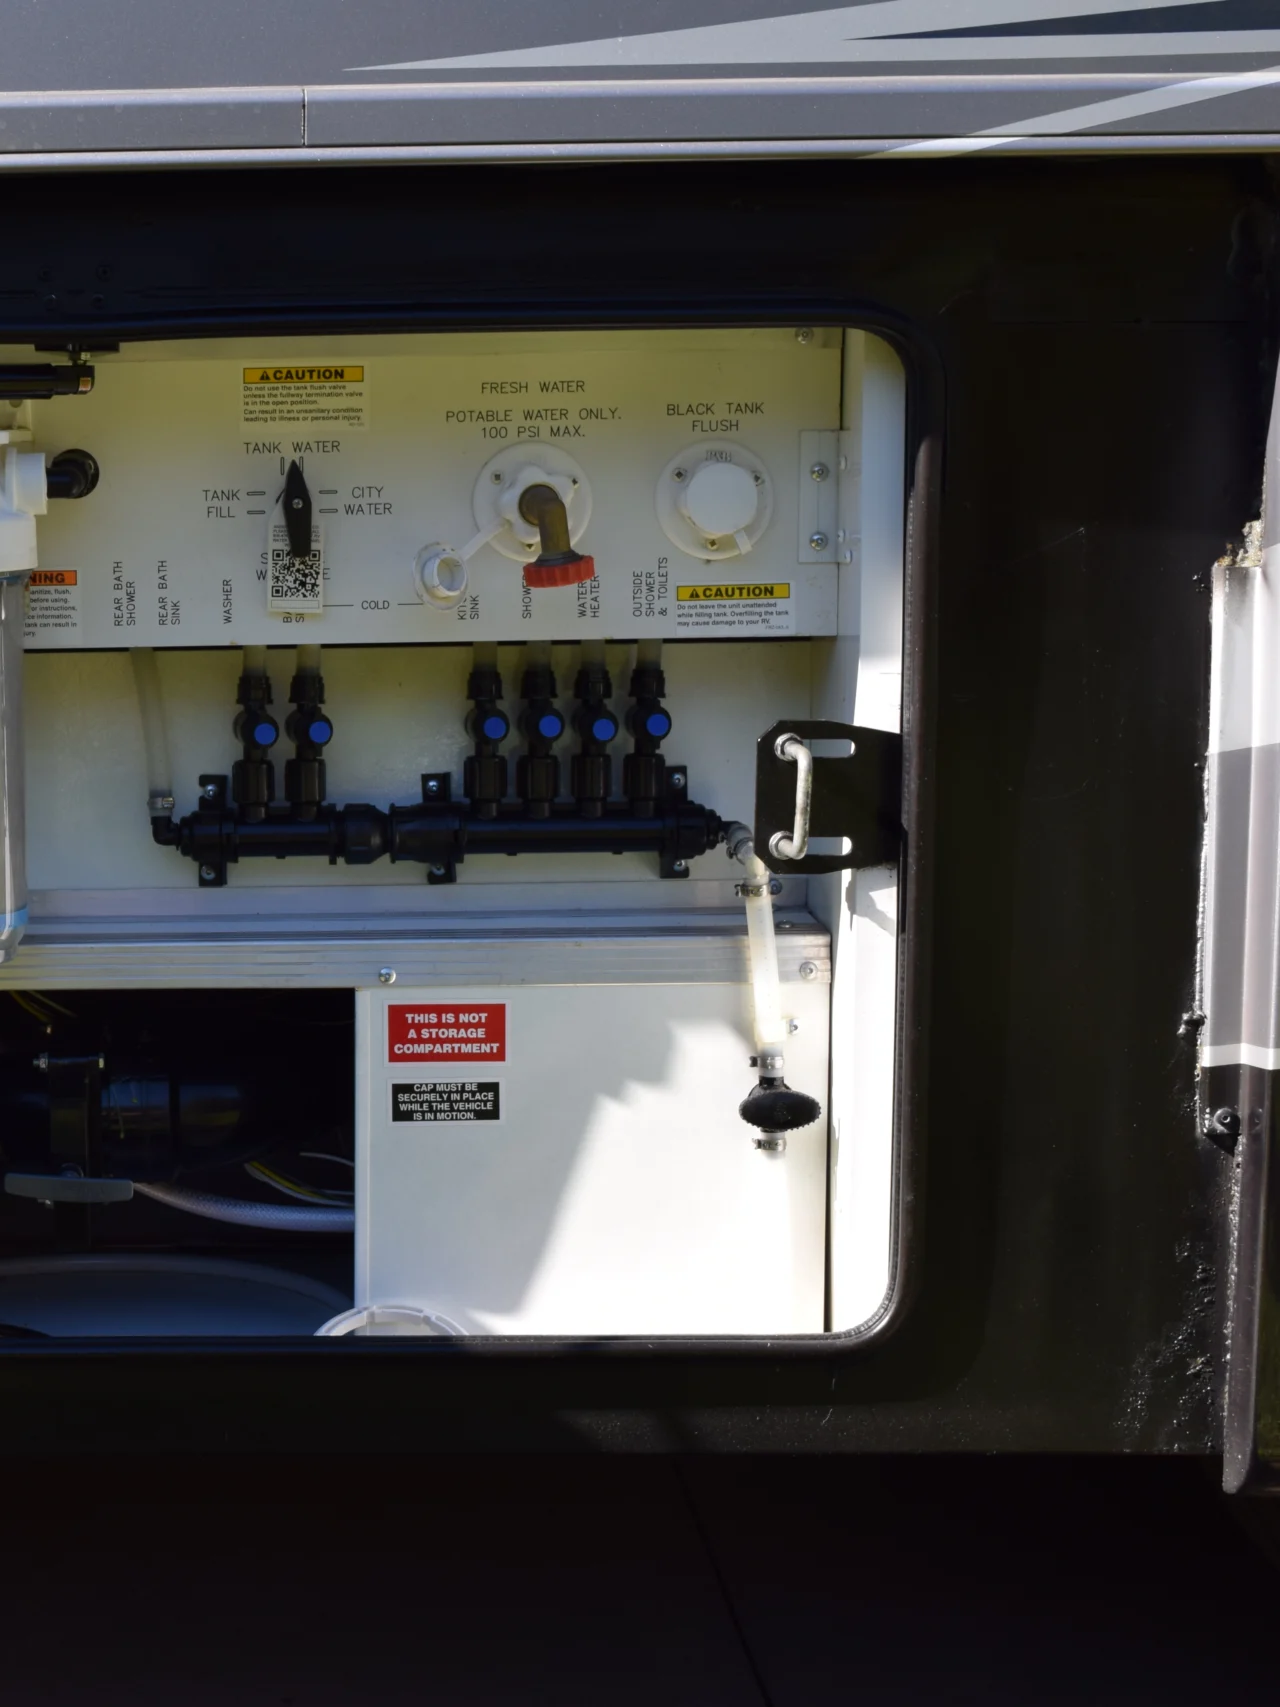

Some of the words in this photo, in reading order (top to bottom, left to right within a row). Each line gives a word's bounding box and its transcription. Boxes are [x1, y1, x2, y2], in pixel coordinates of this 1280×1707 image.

[273, 368, 344, 380] CAUTION
[482, 381, 528, 394] FRESH
[539, 380, 586, 393] WATER
[446, 410, 513, 422] POTABLE
[522, 408, 568, 422] WATER
[579, 408, 622, 420] ONLY.
[666, 403, 715, 416] BLACK
[726, 402, 764, 414] TANK
[482, 426, 508, 438] 100
[517, 426, 540, 438] PSI
[550, 425, 586, 437] MAX.
[692, 420, 739, 432] FLUSH
[244, 442, 282, 454] TANK
[292, 440, 340, 453] WATER
[202, 489, 240, 501] TANK
[352, 486, 384, 498] CITY
[207, 506, 236, 518] FILL
[344, 503, 392, 516] WATER
[112, 561, 122, 590] BATH
[158, 560, 168, 590] BATH
[658, 557, 668, 600] TOILETS
[590, 575, 600, 618] HEATER
[632, 570, 643, 618] OUTSIDE
[645, 571, 654, 617] SHOWER
[702, 586, 774, 598] CAUTION
[126, 580, 136, 626] SHOWER
[222, 578, 232, 624] WASHER
[361, 600, 390, 610] COLD
[578, 581, 587, 618] WATER
[114, 597, 124, 626] REAR
[158, 596, 168, 626] REAR
[170, 600, 180, 626] SINK
[470, 594, 480, 619] SINK
[658, 606, 668, 616] &
[730, 610, 762, 618] Overfilling
[711, 619, 736, 627] damage
[406, 1014, 438, 1024] THIS
[442, 1013, 455, 1023] IS
[459, 1012, 488, 1023] NOT
[408, 1028, 417, 1038] A
[420, 1028, 486, 1038] STORAGE
[394, 1043, 499, 1054] COMPARTMENT
[414, 1084, 434, 1092] CAP
[436, 1083, 462, 1091] MUST
[398, 1093, 448, 1102] SECURELY
[462, 1092, 494, 1100] PLACE
[399, 1103, 429, 1111] WHILE
[432, 1102, 450, 1110] THE
[452, 1102, 493, 1110] VEHICLE
[414, 1112, 422, 1120] IS
[425, 1112, 434, 1120] IN
[437, 1112, 476, 1120] MOTION.
